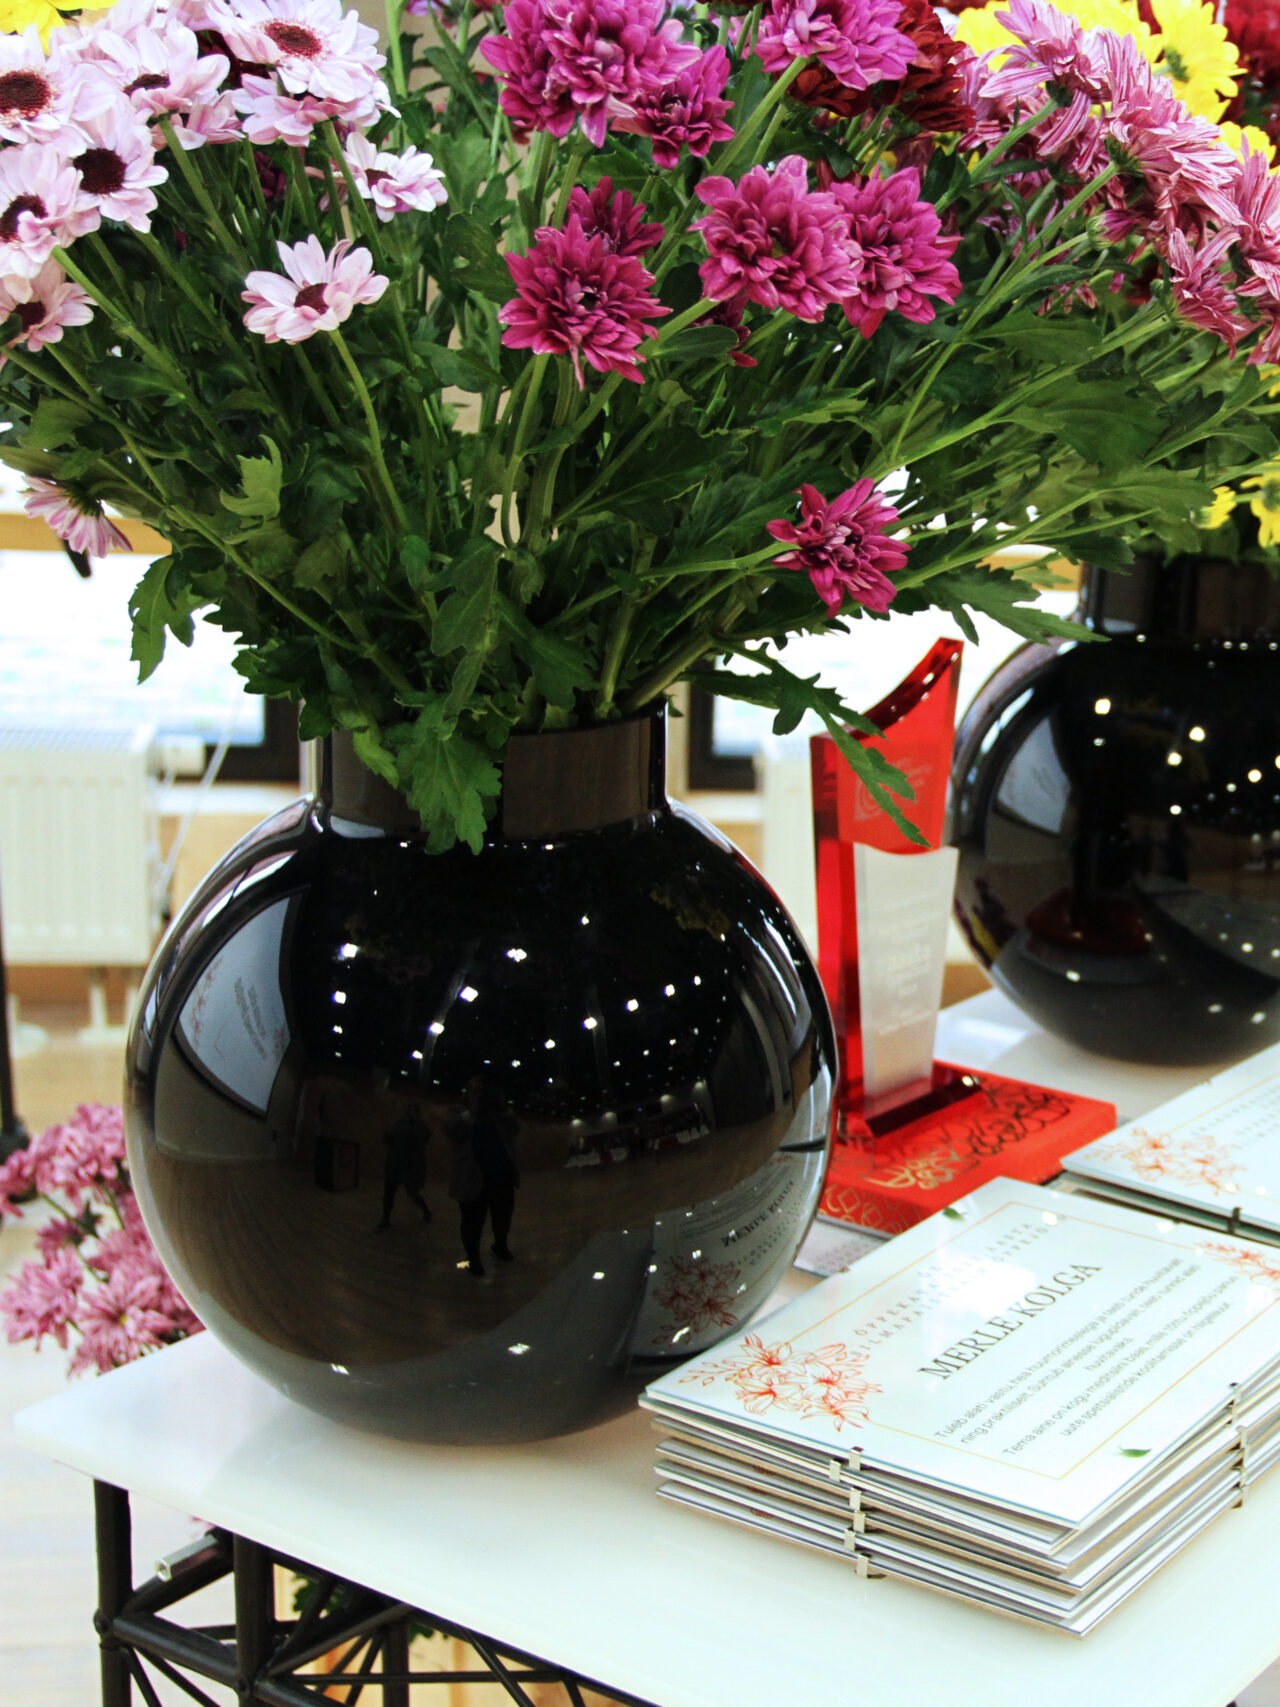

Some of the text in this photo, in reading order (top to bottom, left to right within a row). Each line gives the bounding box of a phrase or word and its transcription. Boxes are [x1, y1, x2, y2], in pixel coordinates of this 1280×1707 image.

[986, 1223, 1032, 1251] AASTA
[919, 1265, 1100, 1378] MERLE KOLGA
[933, 1418, 967, 1437] Tuleb
[964, 1403, 986, 1418] alati
[1008, 1371, 1031, 1383] hea
[1102, 1302, 1125, 1314] teeb
[1121, 1285, 1147, 1301] tunde
[960, 1427, 988, 1443] ning
[1027, 1368, 1064, 1391] Suhtub
[1061, 1344, 1095, 1368] ainesse
[1139, 1295, 1161, 1307] teeb
[1157, 1276, 1185, 1293] tunnid
[1182, 1264, 1200, 1276] alati
[1002, 1434, 1036, 1454] Tema
[1032, 1419, 1055, 1434] aine
[1051, 1409, 1067, 1419] on
[1062, 1392, 1090, 1409] kogu
[1086, 1362, 1127, 1392] meditsiini
[1145, 1331, 1167, 1345] mille
[1060, 1419, 1085, 1435] uute
[1182, 1329, 1194, 1338] on
